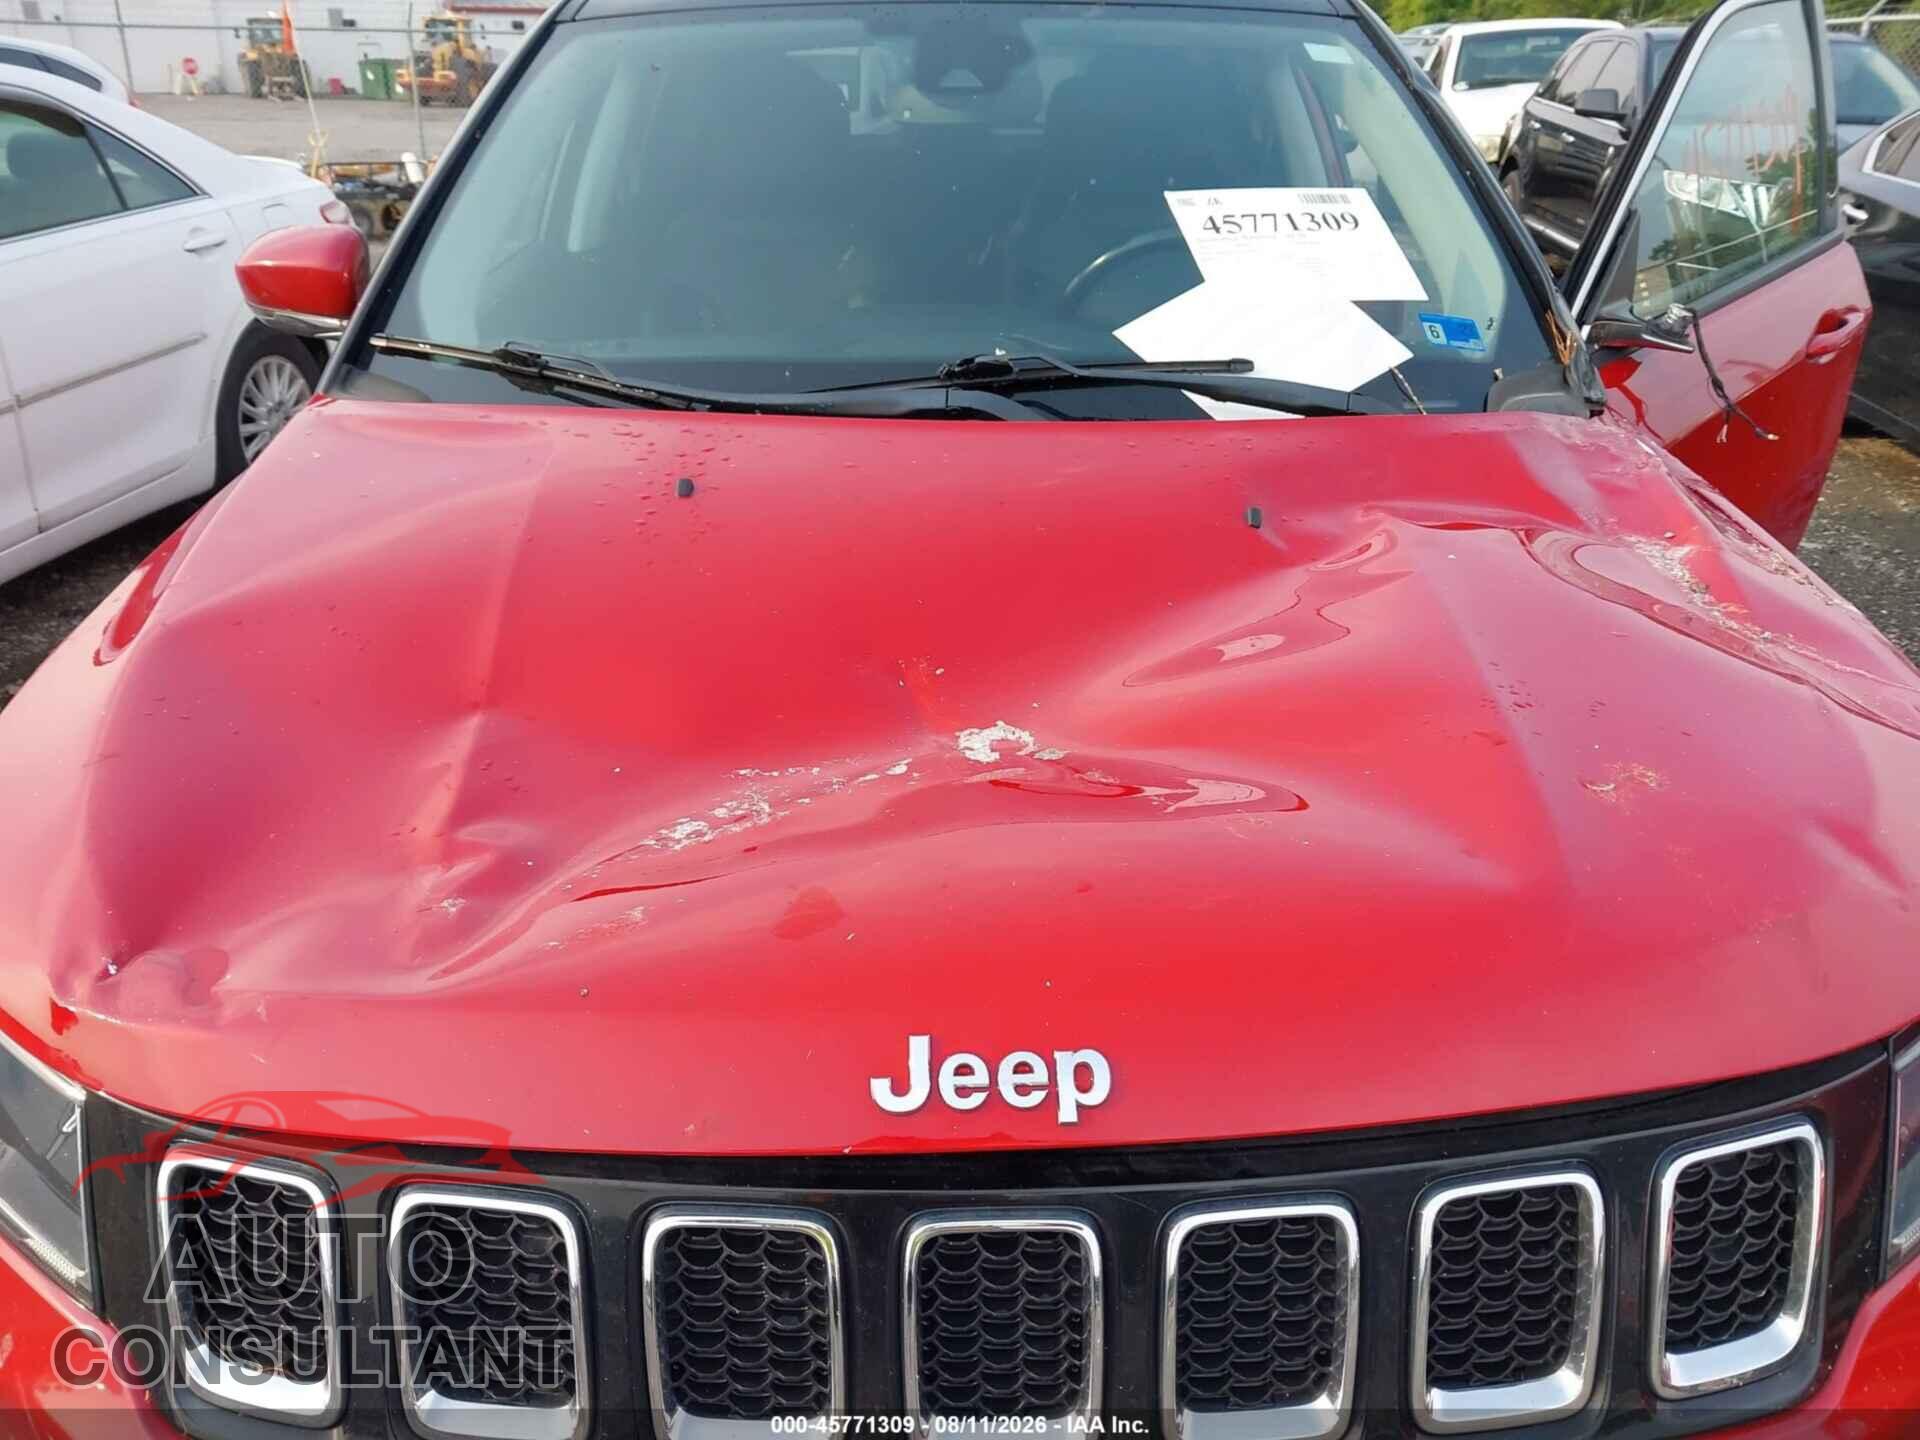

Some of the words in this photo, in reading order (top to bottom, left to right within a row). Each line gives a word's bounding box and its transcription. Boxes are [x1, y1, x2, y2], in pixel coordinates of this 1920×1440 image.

[1202, 212, 1361, 235] 45771309
[1428, 324, 1441, 339] 6
[870, 1034, 1111, 1124] Jeep
